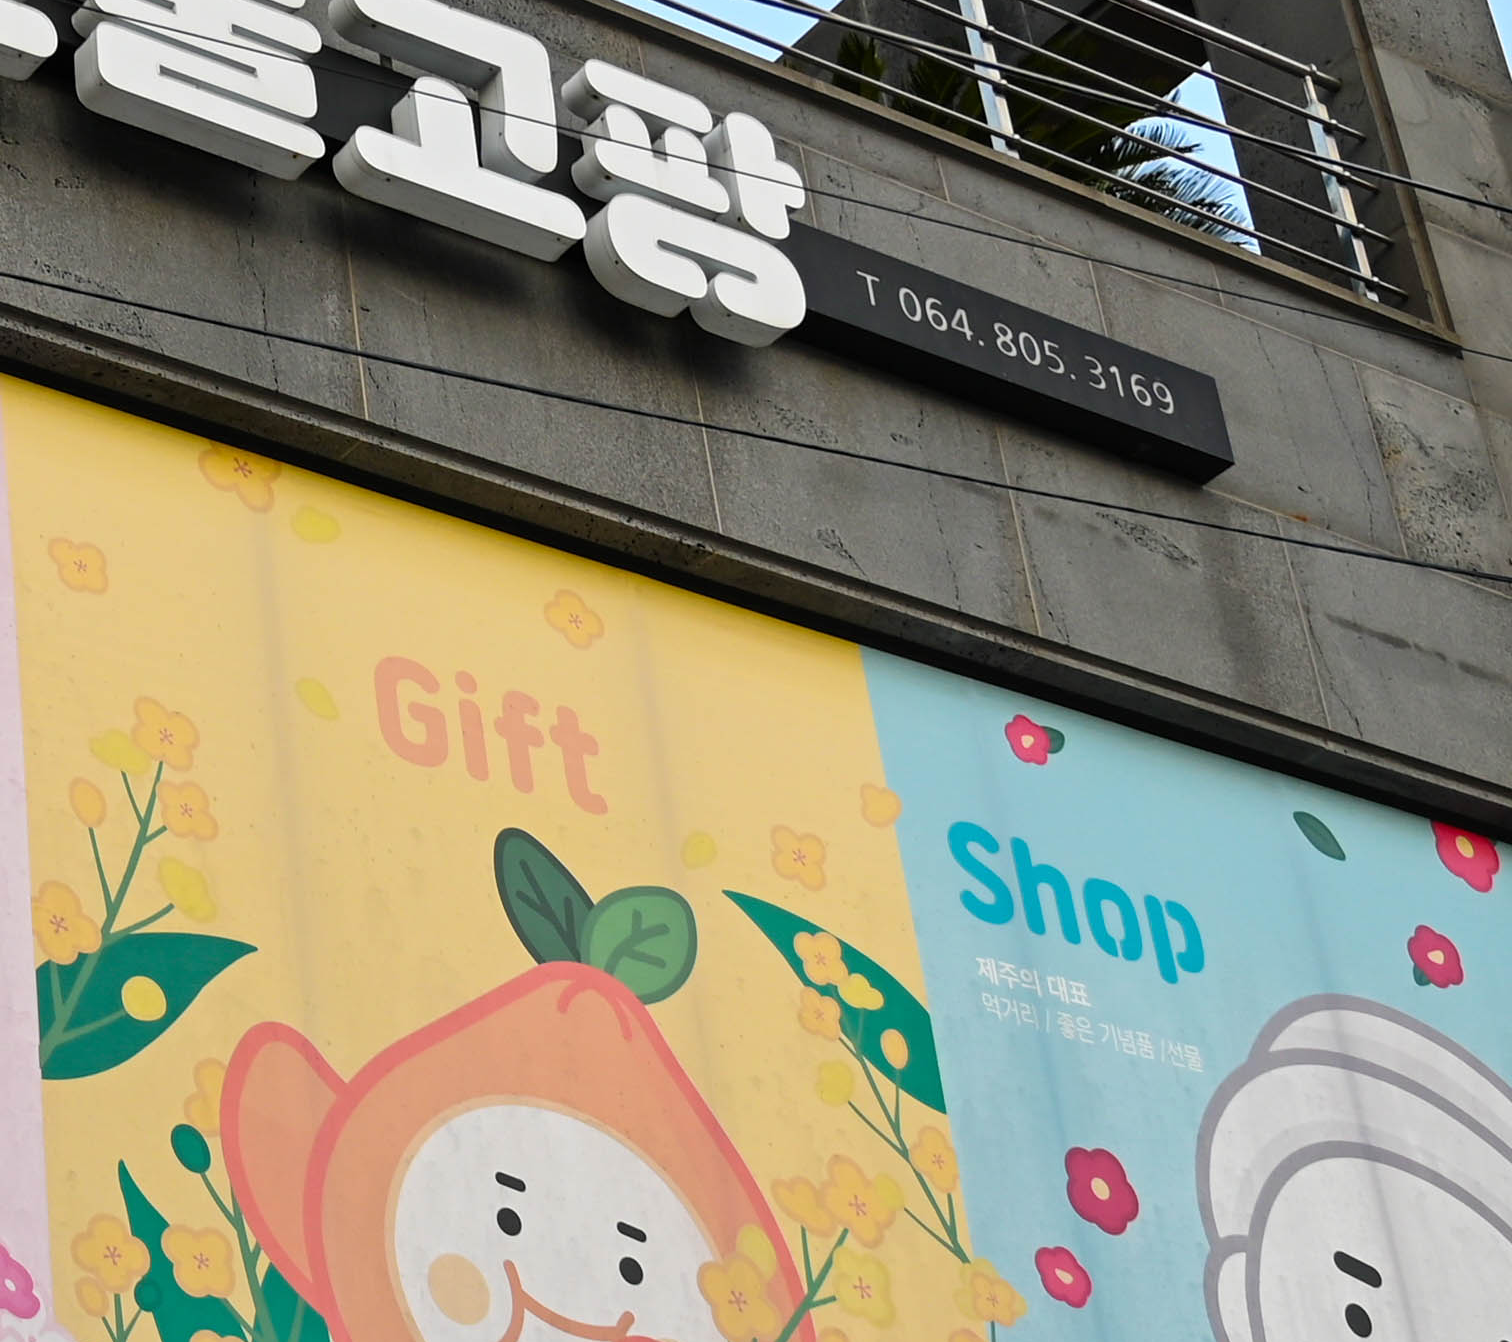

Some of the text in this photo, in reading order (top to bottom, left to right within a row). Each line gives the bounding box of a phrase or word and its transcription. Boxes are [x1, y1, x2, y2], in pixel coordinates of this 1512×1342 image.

[856, 270, 880, 307] T
[374, 656, 608, 815] Gift
[947, 821, 1205, 984] Shop
[975, 957, 1095, 1008] 제주의 대표
[1056, 1011, 1095, 1044] 좋은
